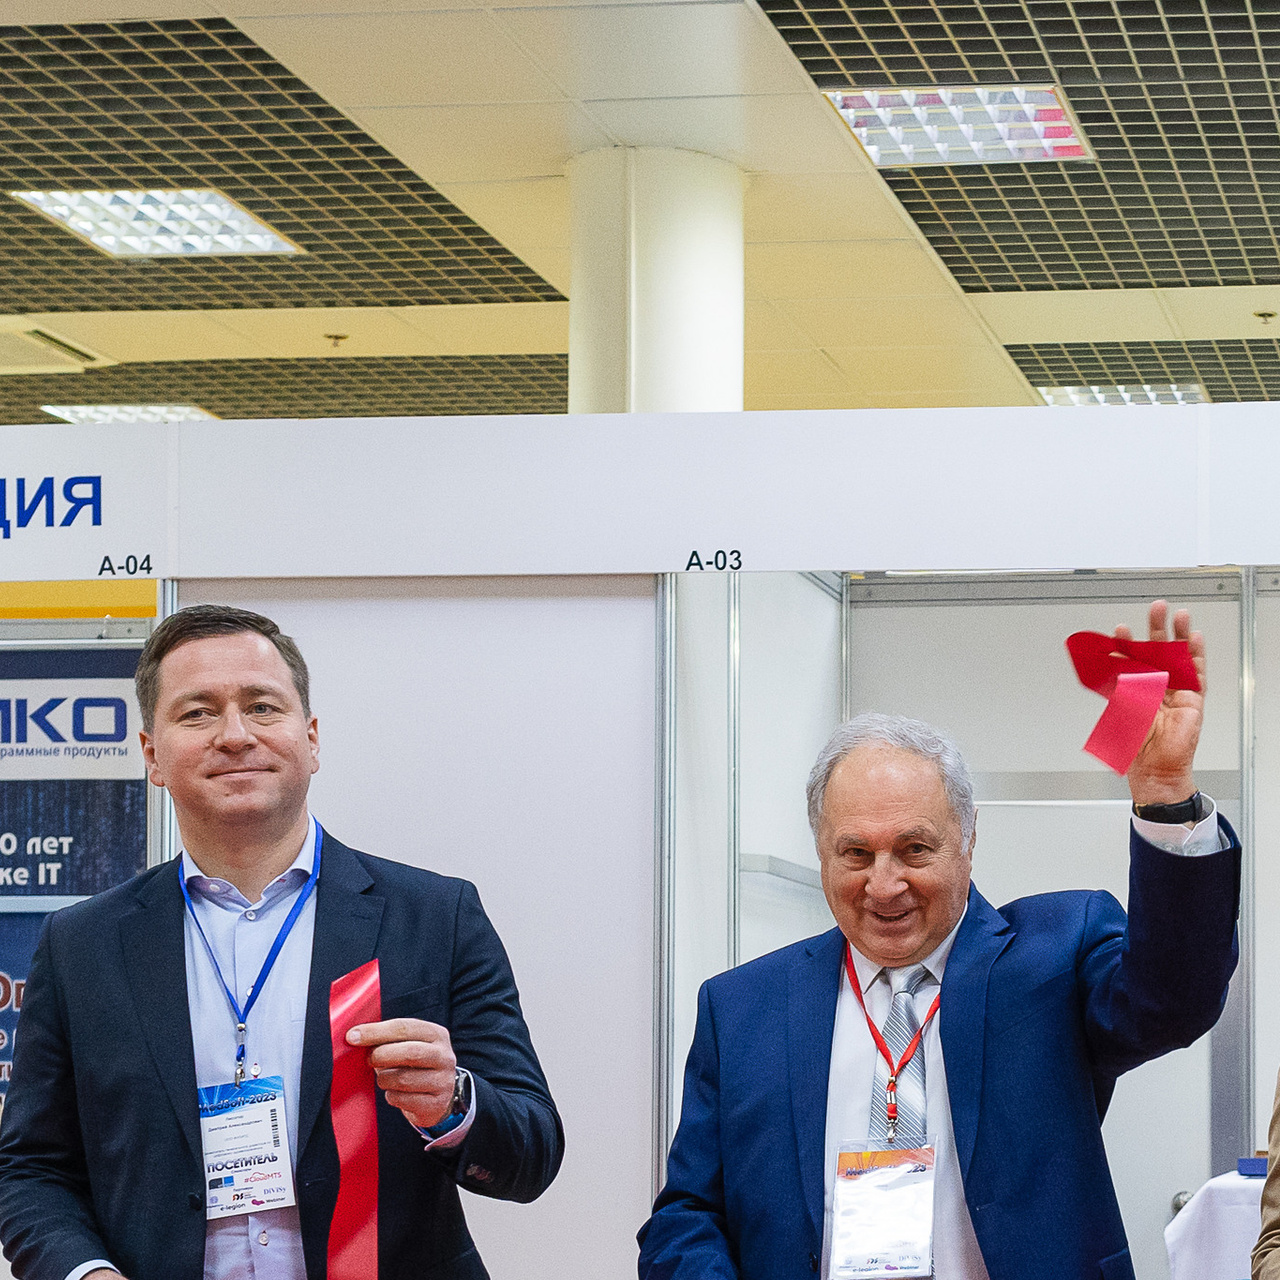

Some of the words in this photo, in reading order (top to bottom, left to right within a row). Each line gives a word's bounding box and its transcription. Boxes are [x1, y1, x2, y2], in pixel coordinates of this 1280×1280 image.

[98, 554, 153, 576] A-04
[685, 550, 743, 571] A-03
[63, 746, 128, 760] продукты
[26, 836, 74, 855] лет
[38, 863, 62, 885] IT
[198, 1092, 277, 1113] MedSoft-2023
[207, 1153, 278, 1173] ПОСЕТИТЕЛЬ
